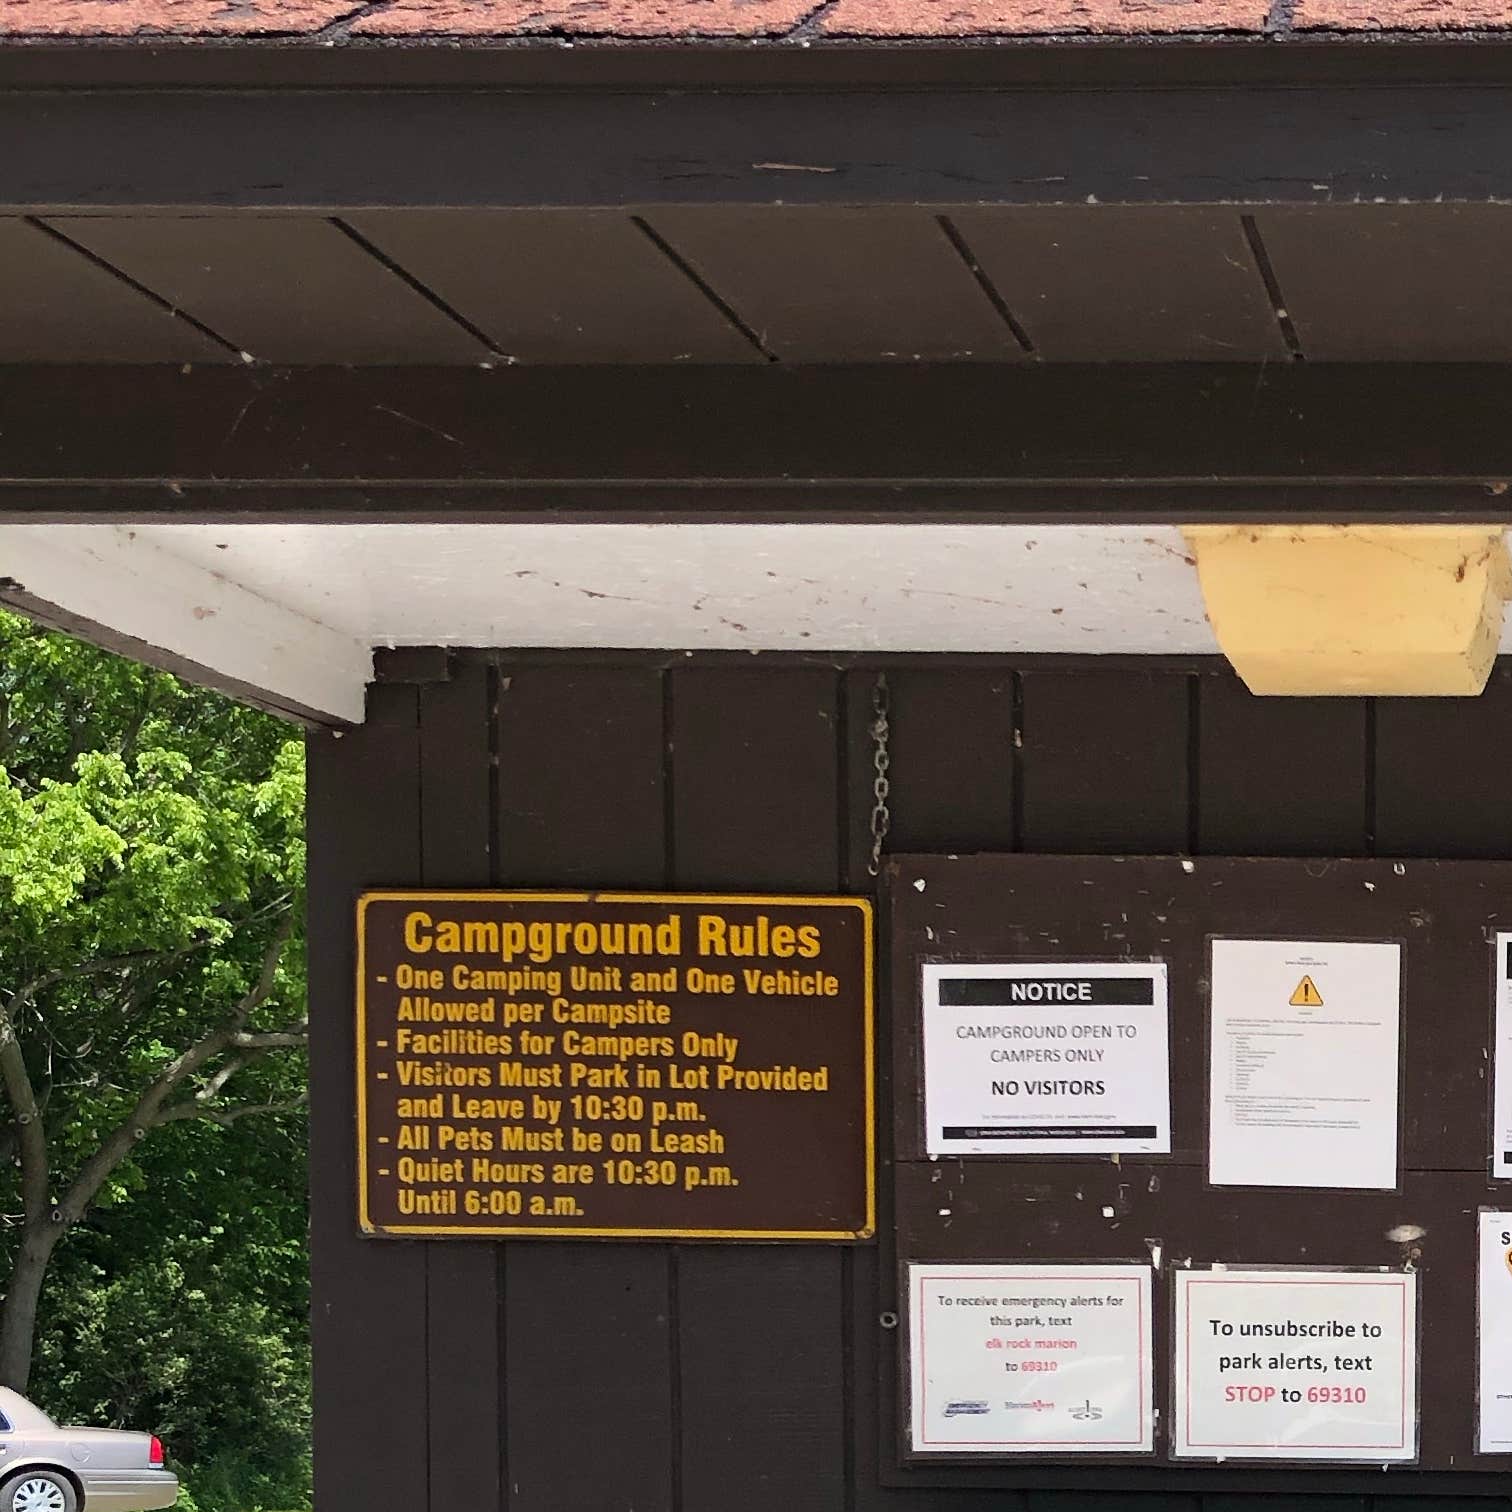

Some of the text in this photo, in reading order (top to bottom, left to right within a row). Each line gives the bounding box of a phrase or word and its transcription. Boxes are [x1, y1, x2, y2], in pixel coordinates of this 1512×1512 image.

[404, 911, 820, 963] Campground Rules
[396, 964, 838, 996] One Camping Unit and One Vehicle
[1011, 982, 1092, 1000] NOTICE
[397, 997, 670, 1029] Allowed per Campsite
[956, 1024, 1136, 1039] CAMPGROUND OPEN TO
[397, 1028, 738, 1062] Facilities for Campers Only
[990, 1048, 1104, 1062] CAMPERS ONLY
[396, 1061, 827, 1091] Visitors Must Park in Lot Provided
[991, 1080, 1105, 1095] NO VISITORS
[397, 1093, 706, 1125] and Leave by 10:30 p.m.
[397, 1125, 724, 1154] All Pets Must be on Leash
[397, 1157, 738, 1191] Quiet Hours are 10:30 p.m.
[398, 1189, 584, 1215] Until 6:00 a.m.
[937, 1295, 1124, 1308] To receive emergency alerts for
[989, 1316, 1072, 1327] this park, text
[1209, 1319, 1381, 1337] To unsubscribe to
[985, 1339, 1077, 1349] elk rock marion
[1005, 1361, 1057, 1371] to 69310
[1219, 1353, 1372, 1373] park alerts, text
[1225, 1385, 1365, 1403] STOP to 69310
